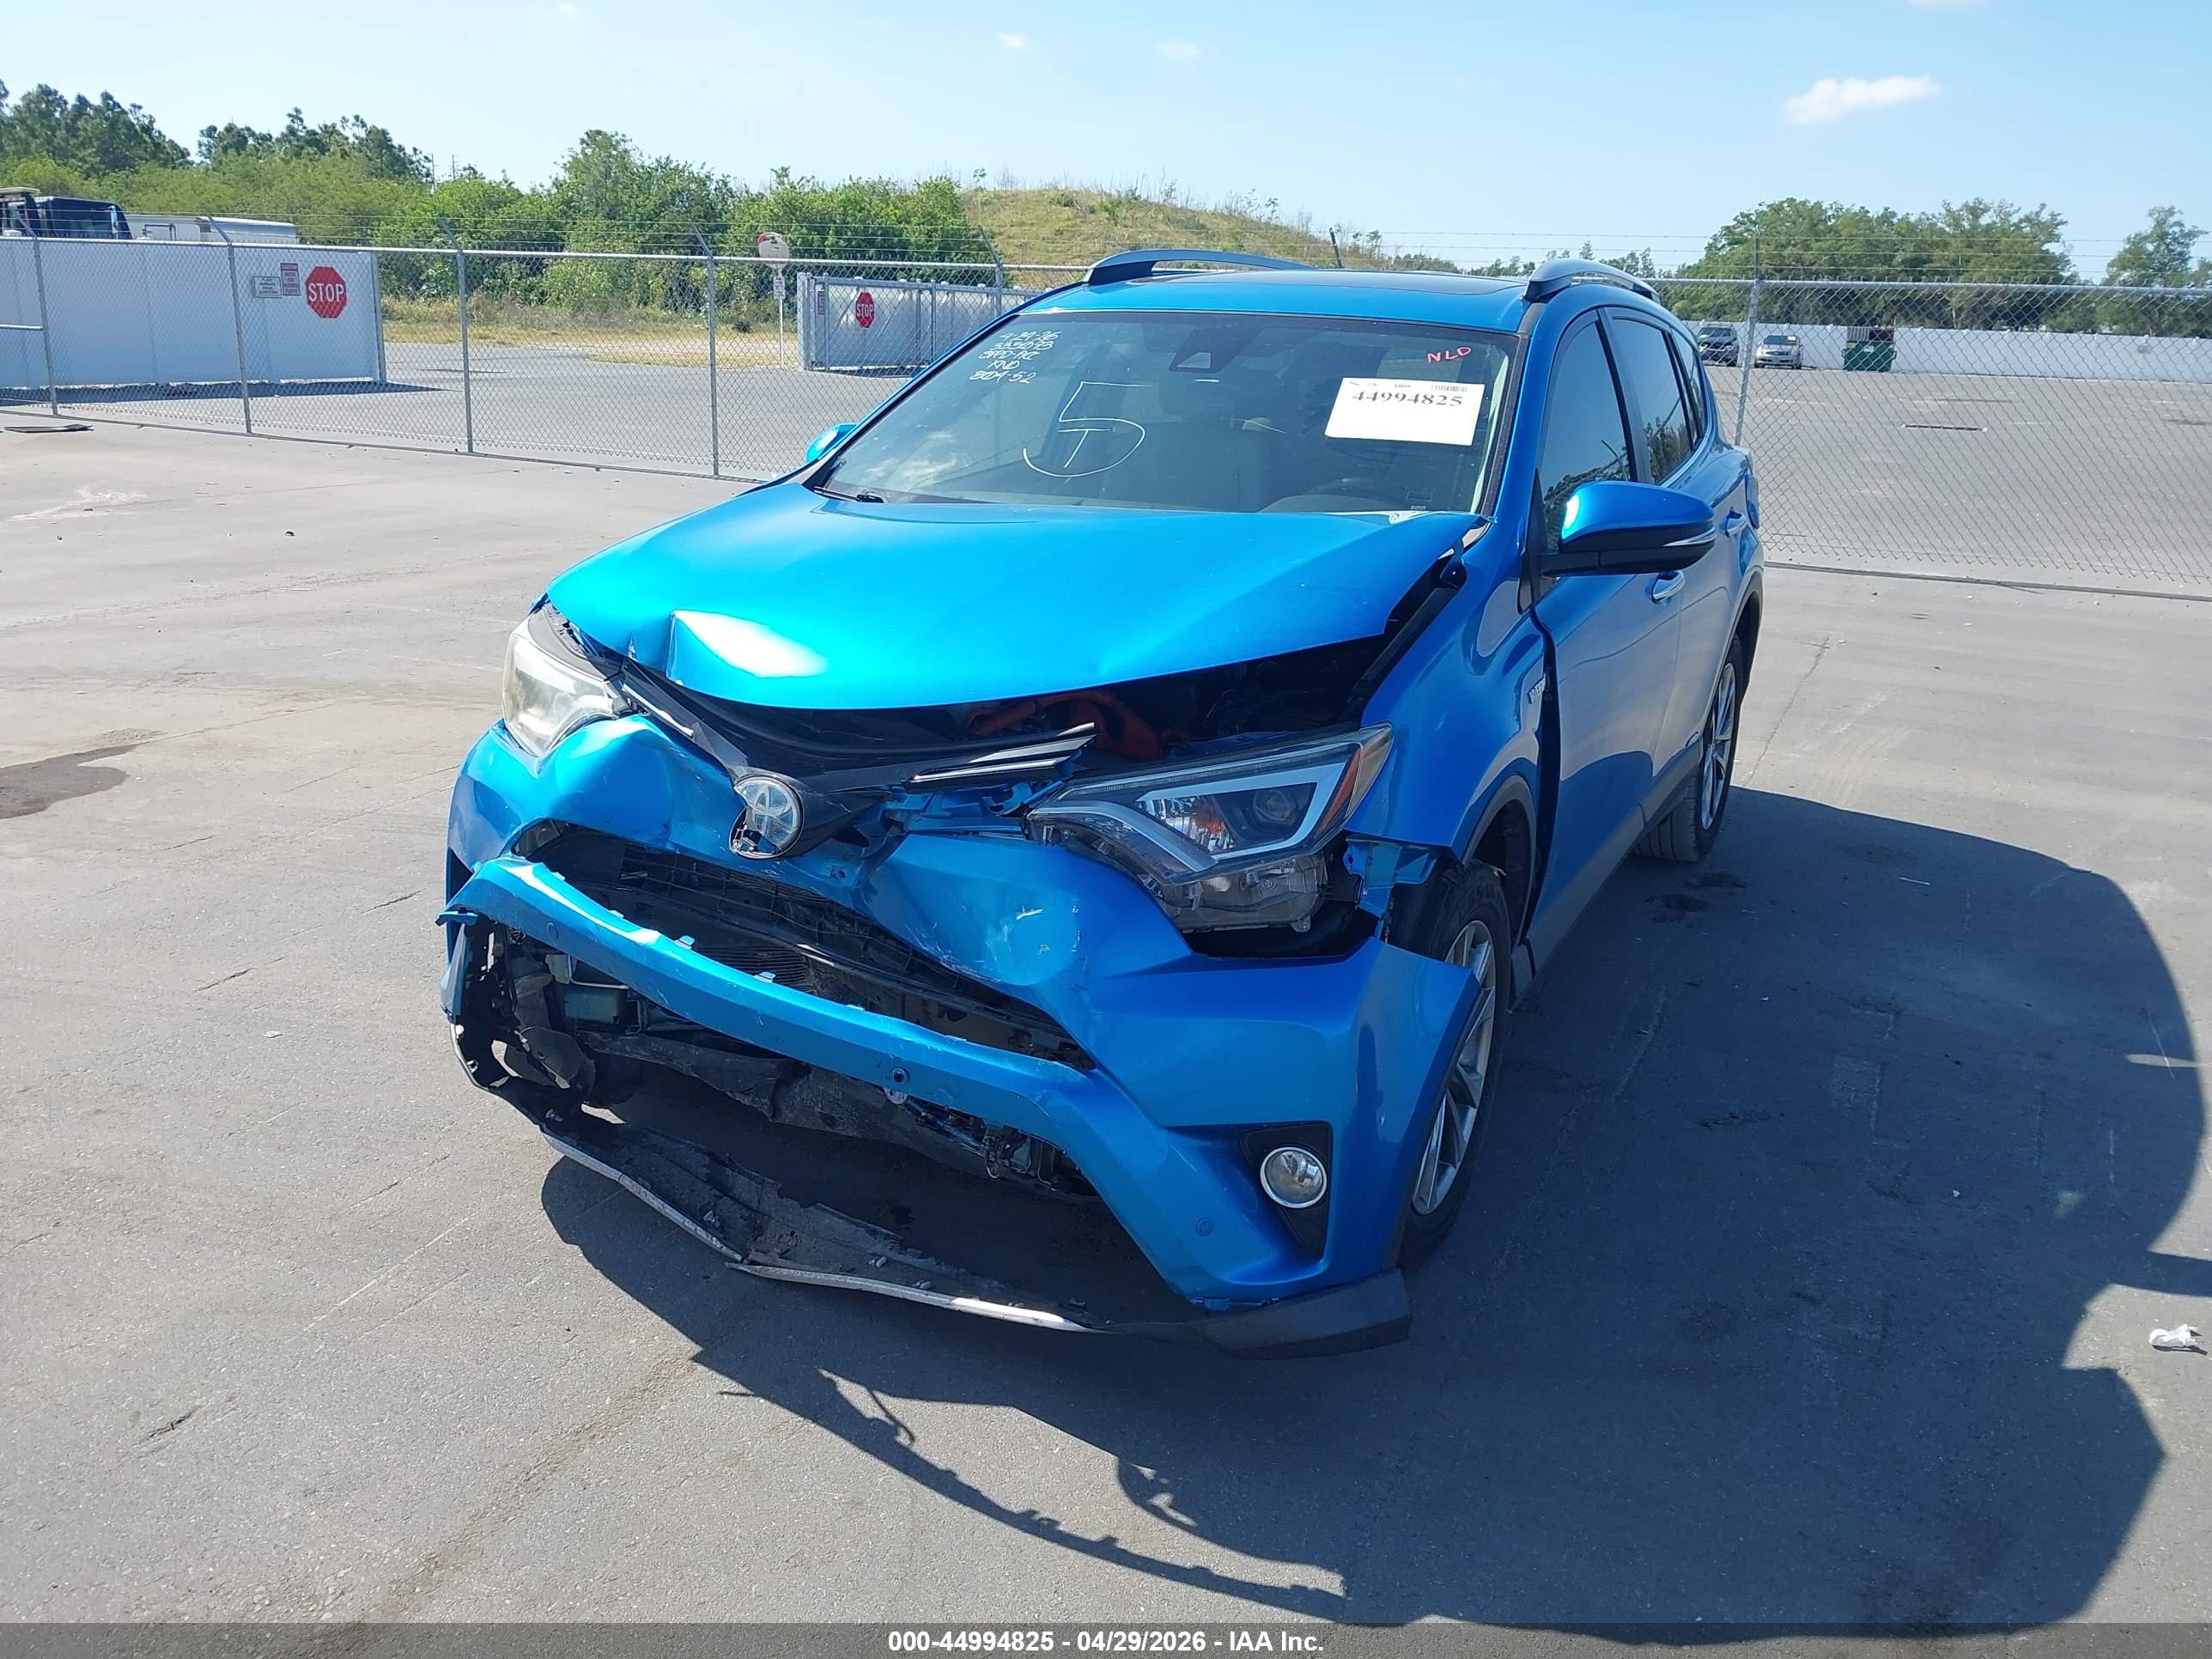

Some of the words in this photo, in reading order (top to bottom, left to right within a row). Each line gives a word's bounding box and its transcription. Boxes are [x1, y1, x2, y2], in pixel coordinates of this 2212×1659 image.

[308, 283, 344, 302] STOP
[856, 303, 874, 318] STOP
[1352, 391, 1463, 407] 44994825
